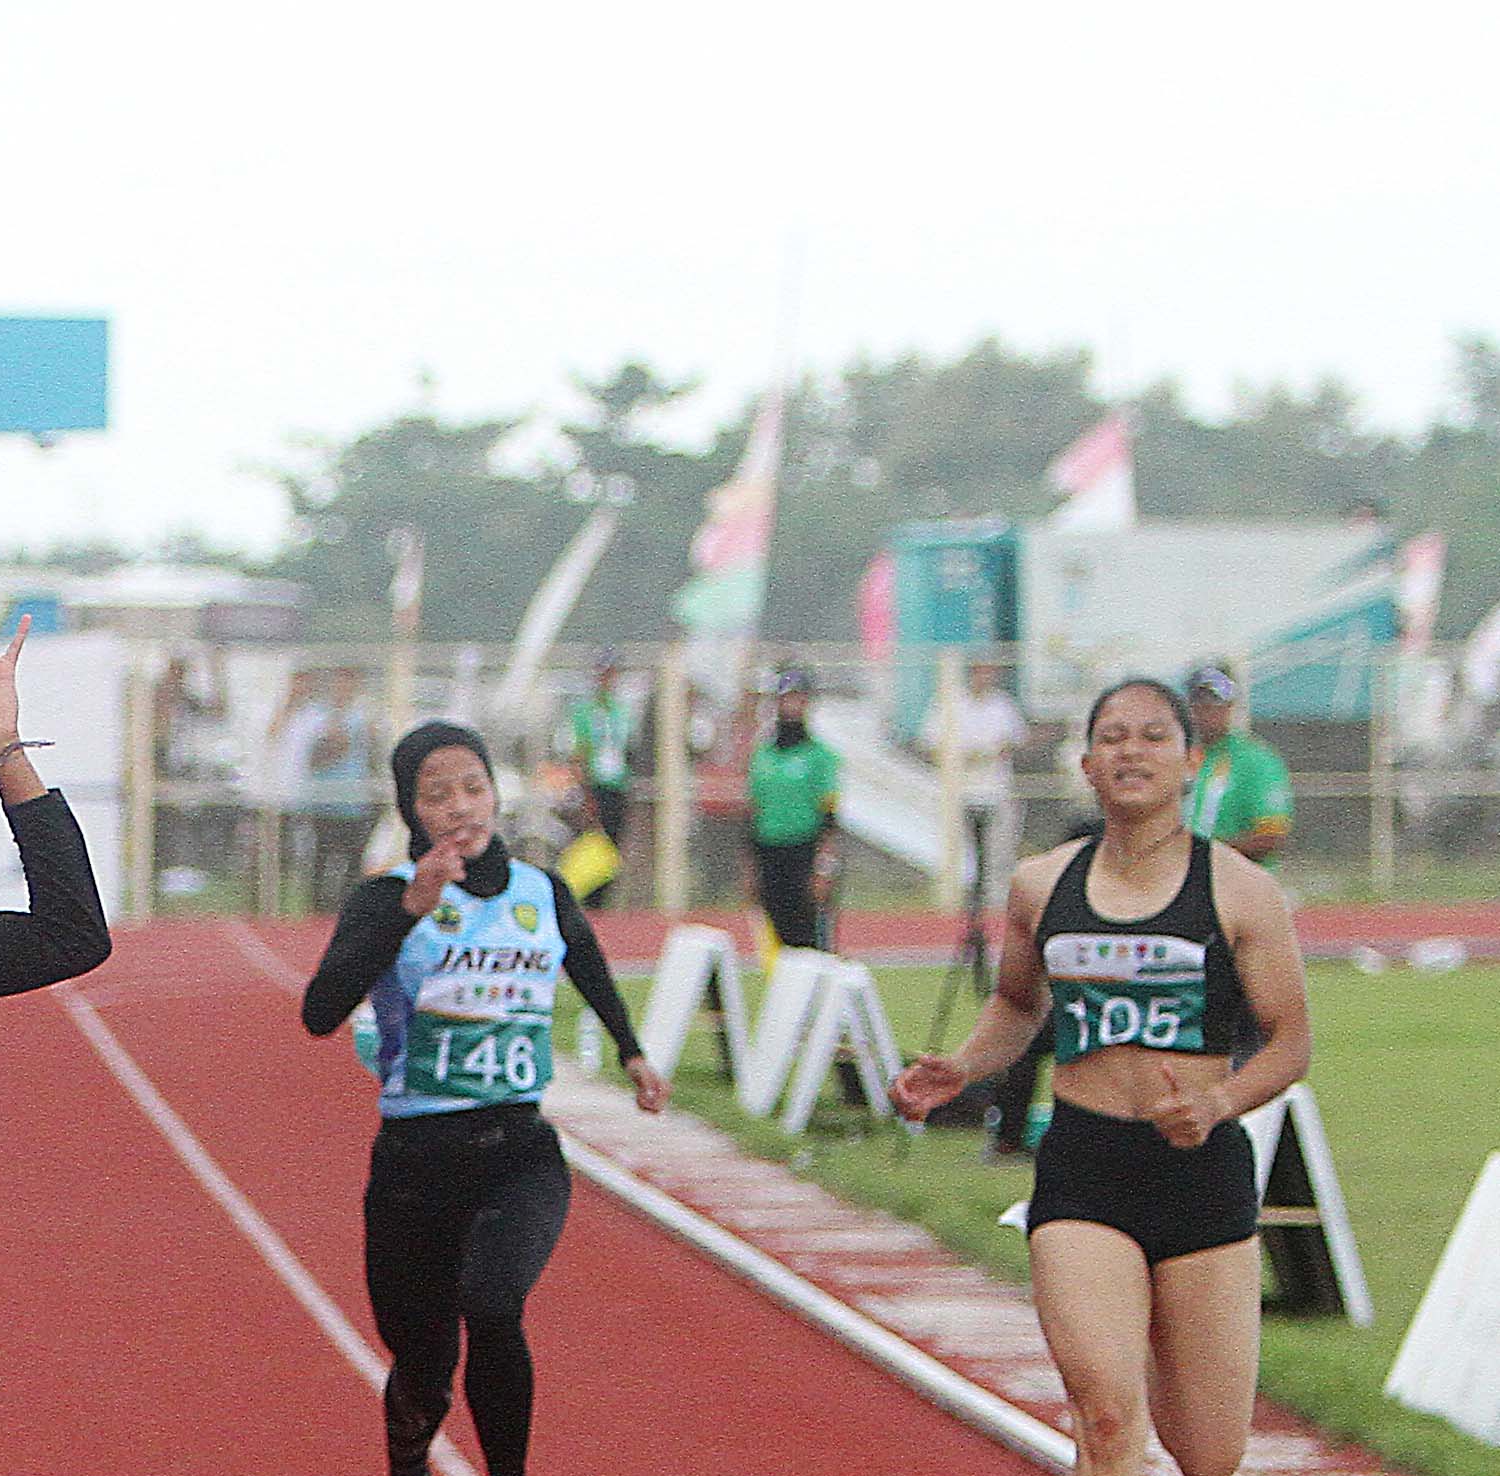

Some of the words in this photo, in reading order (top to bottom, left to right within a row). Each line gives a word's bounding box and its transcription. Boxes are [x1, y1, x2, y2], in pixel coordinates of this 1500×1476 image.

[435, 946, 552, 974] JATENG
[1064, 997, 1181, 1051] 105
[434, 1029, 538, 1090] 146
